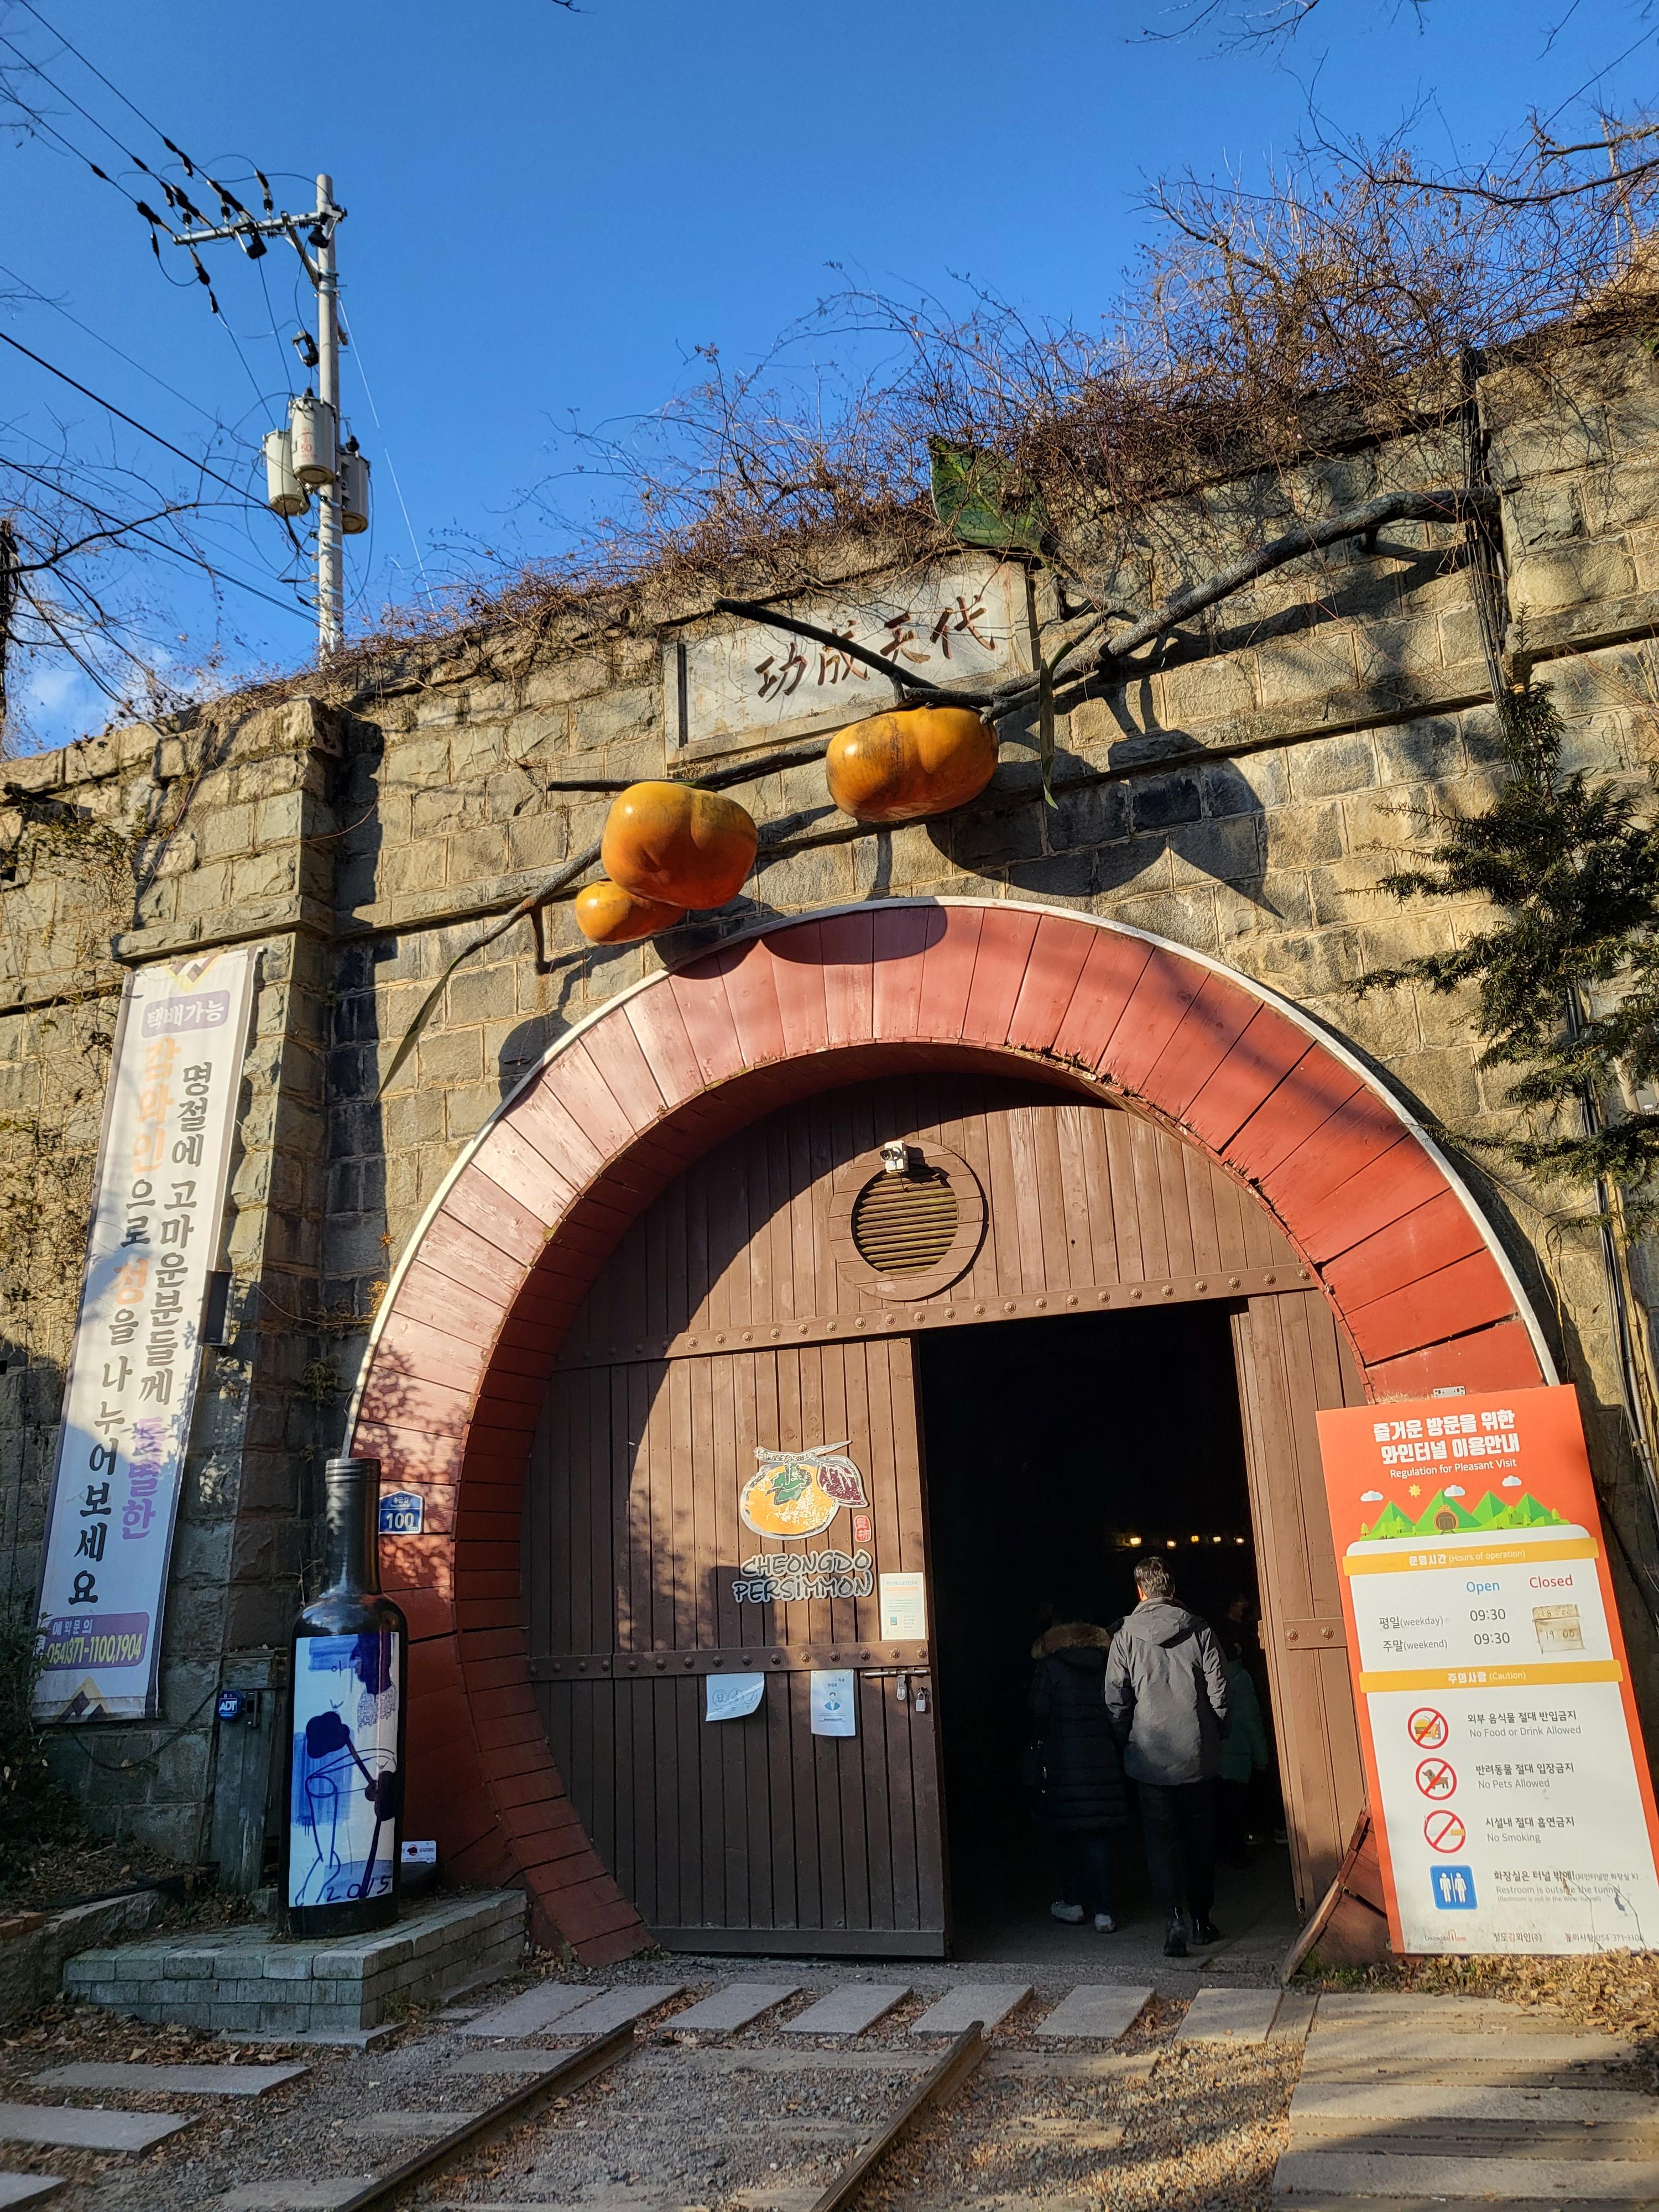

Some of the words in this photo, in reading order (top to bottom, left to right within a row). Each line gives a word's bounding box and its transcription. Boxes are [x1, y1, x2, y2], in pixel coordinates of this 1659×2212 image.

[147, 1000, 225, 1029] 택배가능
[1373, 1419, 1423, 1442] 즐거운
[1426, 1413, 1477, 1437] 방문을
[1480, 1409, 1515, 1431] 위한
[1381, 1440, 1448, 1464] 와인터널
[1452, 1433, 1520, 1458] 이용안내
[1390, 1466, 1437, 1479] Regulation
[1439, 1464, 1453, 1473] for
[1454, 1460, 1494, 1472] Pleasant
[1495, 1458, 1517, 1468] Visit
[386, 1512, 414, 1529] 100
[1449, 1553, 1474, 1562] (Hours
[1485, 1550, 1526, 1561] operation)
[742, 1551, 870, 1575] CHEONGDO
[1466, 1581, 1500, 1595] Open
[1529, 1574, 1573, 1588] Closed
[1470, 1609, 1506, 1621] 09:30
[1474, 1632, 1510, 1645] 09:30
[1489, 1671, 1526, 1681] (Caution)
[219, 1700, 237, 1712] ADT
[1467, 1713, 1485, 1724] 외부
[1488, 1713, 1515, 1724] 음식물
[1519, 1711, 1537, 1723] 절대
[1539, 1710, 1577, 1722] 반입금지
[1469, 1729, 1482, 1738] No
[1484, 1728, 1506, 1737] Food
[1520, 1726, 1544, 1736] Drink
[1546, 1725, 1582, 1735] Allowed
[1475, 1764, 1512, 1776] 반려동물
[1515, 1764, 1534, 1775] 절대
[1536, 1762, 1574, 1775] 입장금지
[1478, 1780, 1490, 1789] No
[1493, 1780, 1512, 1788] Pets
[1515, 1778, 1550, 1788] Allowed
[1485, 1817, 1513, 1829] 시설내
[1515, 1817, 1535, 1828] 절대
[1537, 1816, 1575, 1828] 흡연금지
[1487, 1833, 1500, 1842] No
[1502, 1832, 1541, 1844] Smoking
[1494, 1870, 1530, 1882] 화장실은
[1532, 1870, 1551, 1882] 터널
[1496, 1886, 1535, 1894] Restroom
[1537, 1886, 1543, 1894] is
